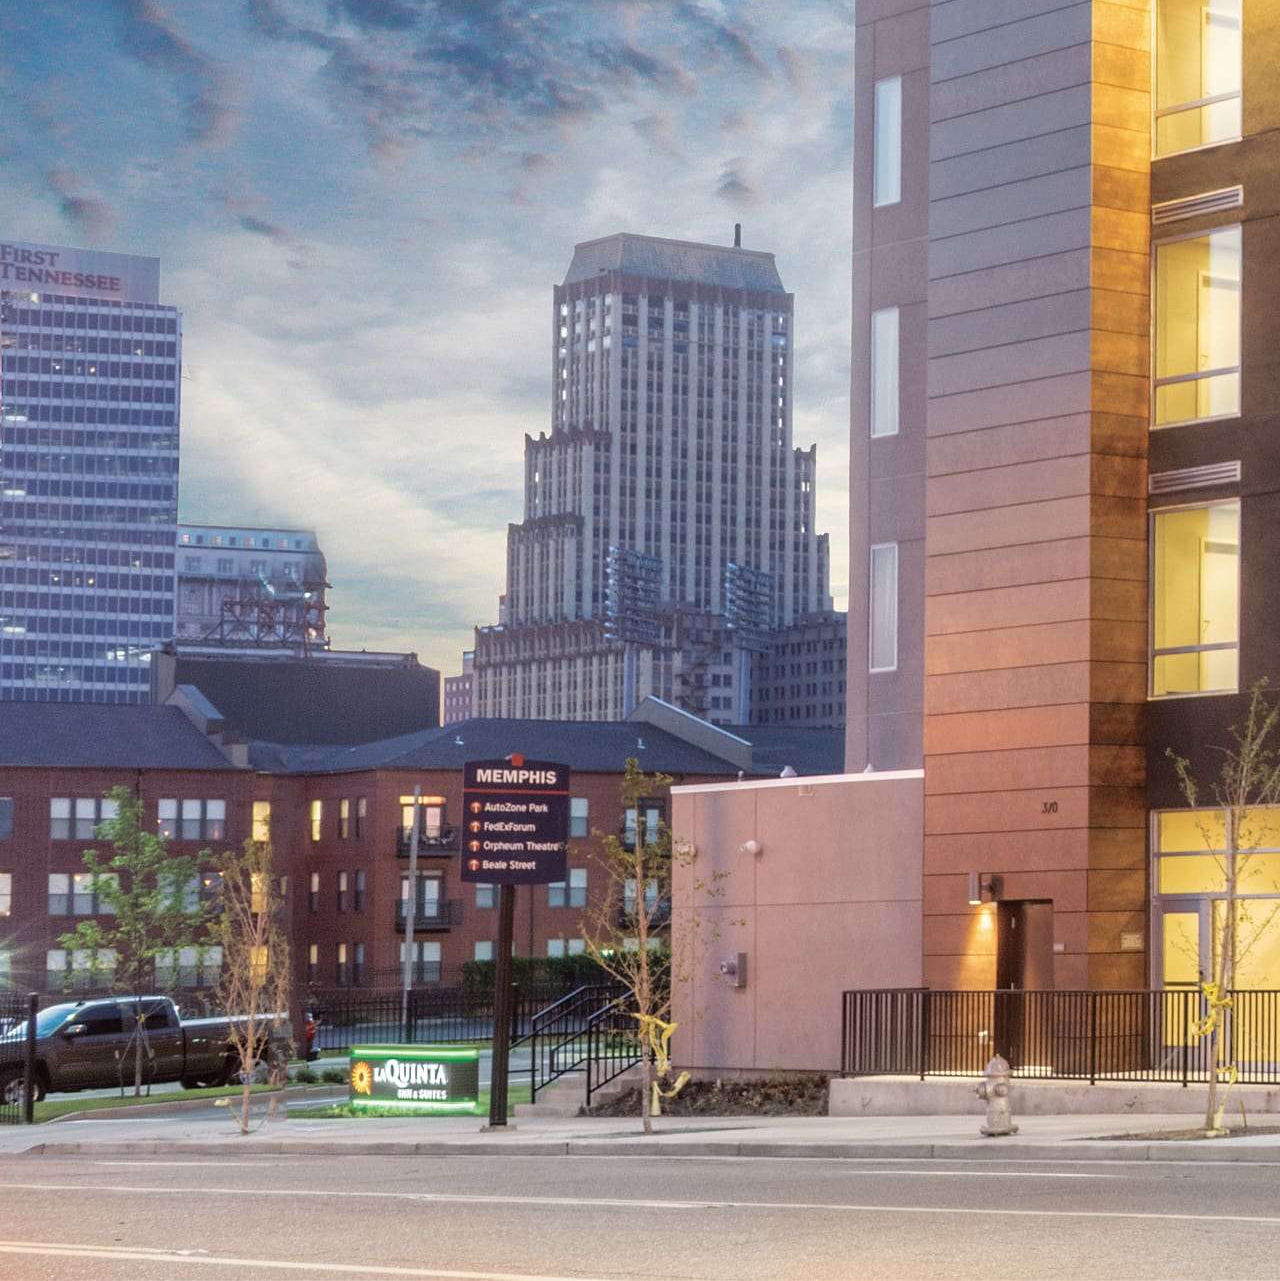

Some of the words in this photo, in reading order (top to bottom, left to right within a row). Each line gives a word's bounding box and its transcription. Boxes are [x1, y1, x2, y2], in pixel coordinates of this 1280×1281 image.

[0, 244, 60, 267] FIRST
[0, 261, 122, 291] TENNESSEE
[476, 768, 558, 785] MEMPHIS
[484, 802, 527, 813] AutoZone
[528, 803, 549, 813] Park
[483, 821, 536, 832] FedExForum
[483, 840, 525, 853] Orpheum
[526, 841, 560, 852] Theatre
[482, 859, 508, 870] Beale
[509, 860, 537, 871] Street
[384, 1059, 448, 1088] QUINTA
[419, 1089, 448, 1101] SUITES
